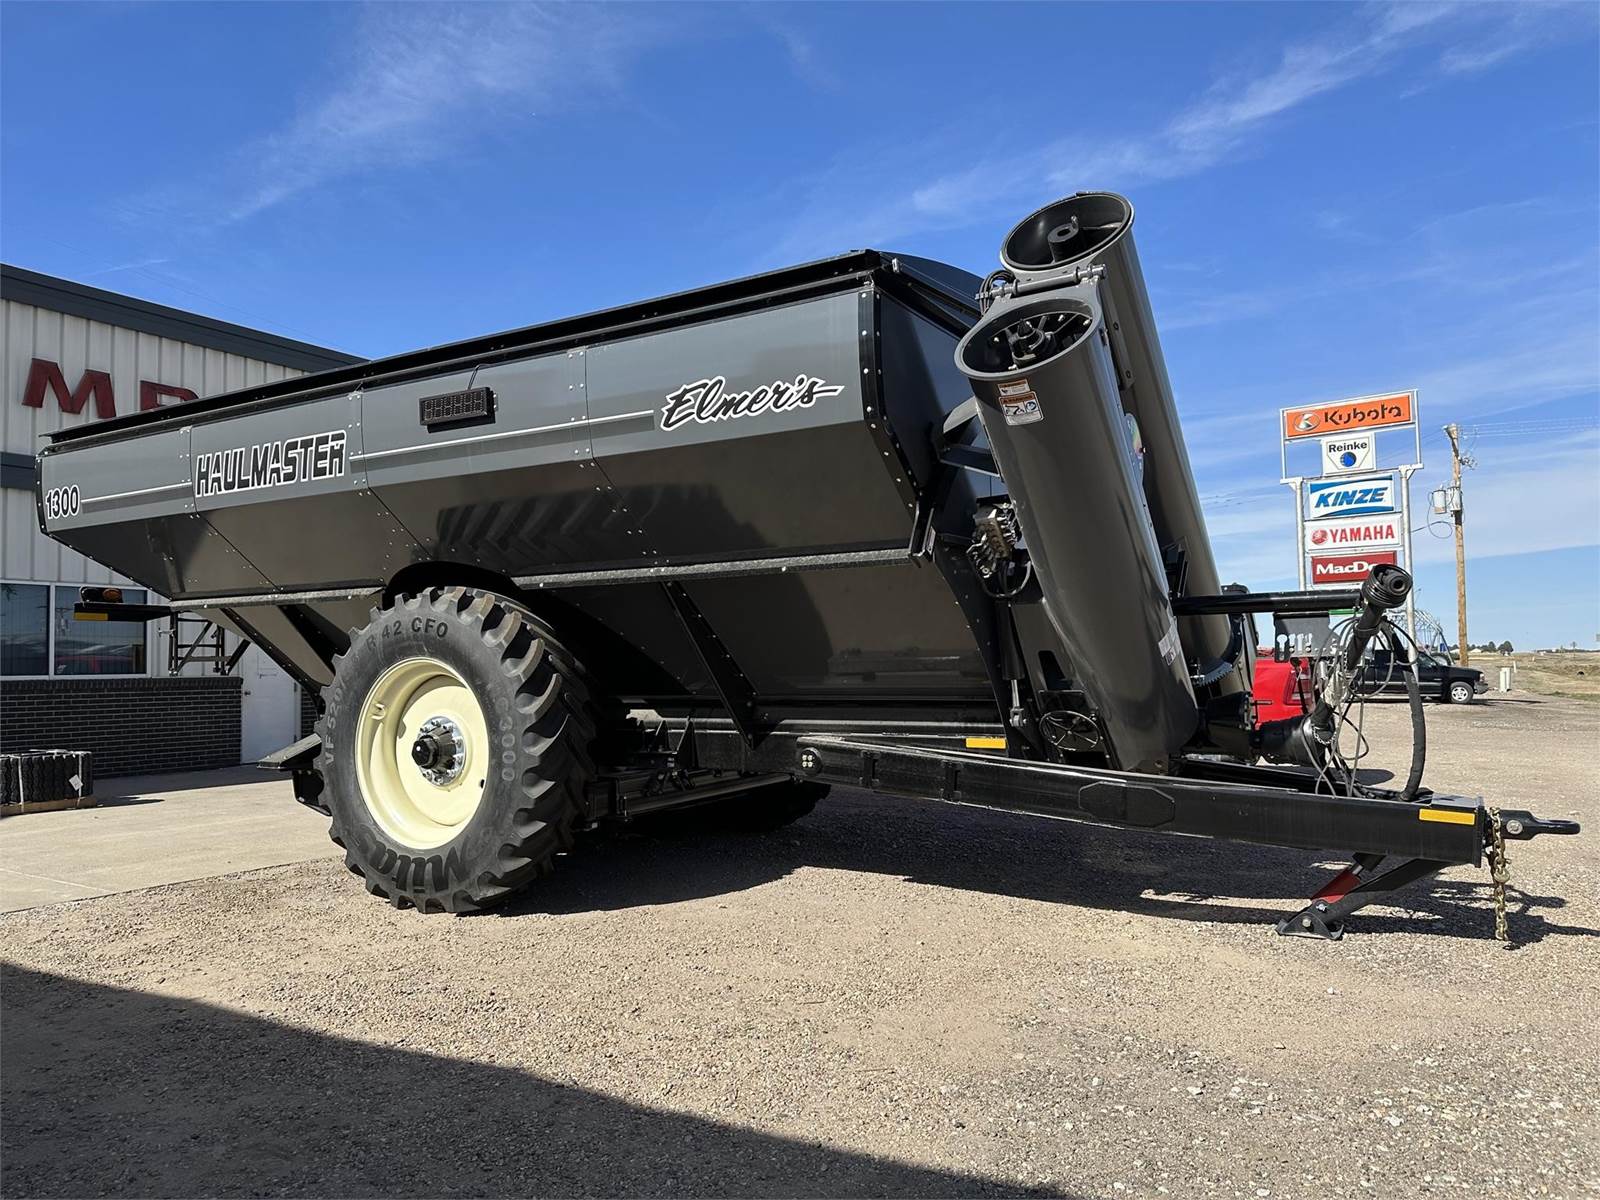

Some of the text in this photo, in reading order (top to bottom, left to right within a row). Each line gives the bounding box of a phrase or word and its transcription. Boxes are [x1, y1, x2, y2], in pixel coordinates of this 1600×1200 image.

[660, 374, 845, 431] Elmer's
[1324, 403, 1402, 426] Kubota
[1328, 441, 1368, 453] Reinke
[195, 429, 347, 498] HAULMASTER
[45, 484, 81, 519] 1300
[1314, 487, 1388, 509] KINZE
[1329, 524, 1395, 543] YAMAHA
[1316, 560, 1378, 575] MacD
[411, 616, 449, 639] CFO
